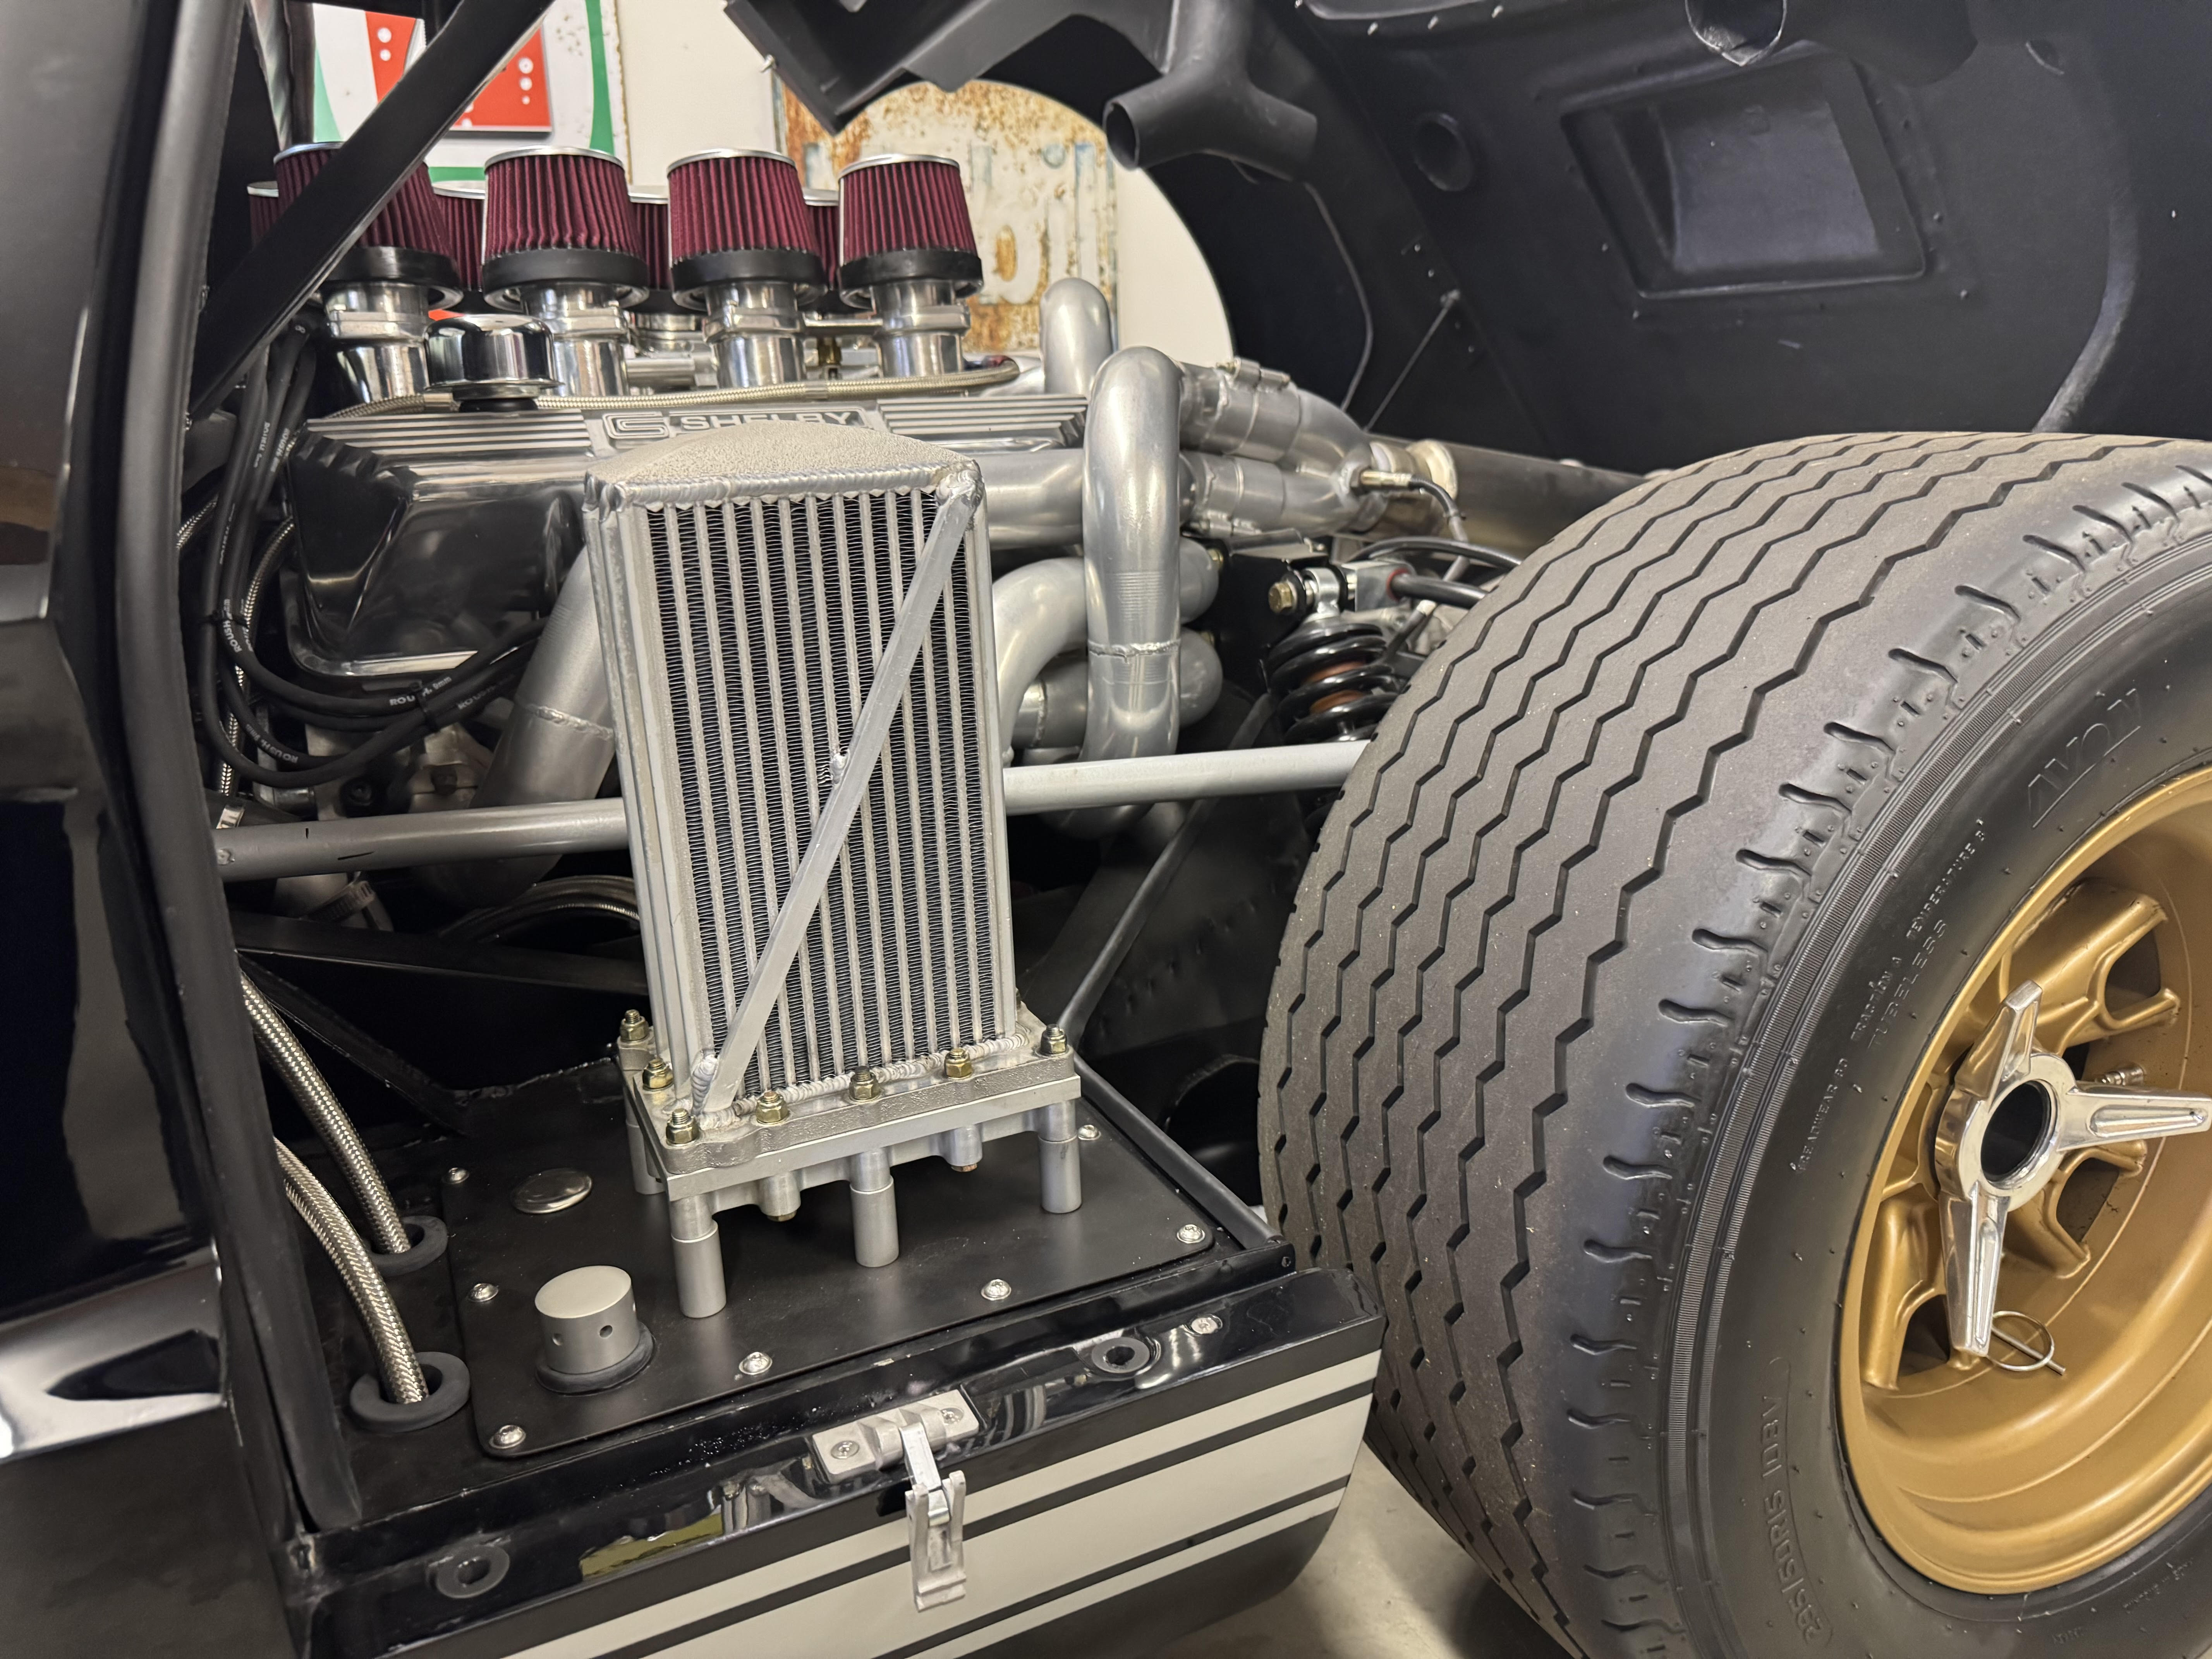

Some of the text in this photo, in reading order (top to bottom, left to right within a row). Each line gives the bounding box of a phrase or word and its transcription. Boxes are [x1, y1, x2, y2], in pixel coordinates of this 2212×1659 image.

[1850, 970, 1892, 1041] TRACTION
[1906, 842, 1975, 939] TEMPERATURE
[1867, 919, 1946, 1049] TUBELESS
